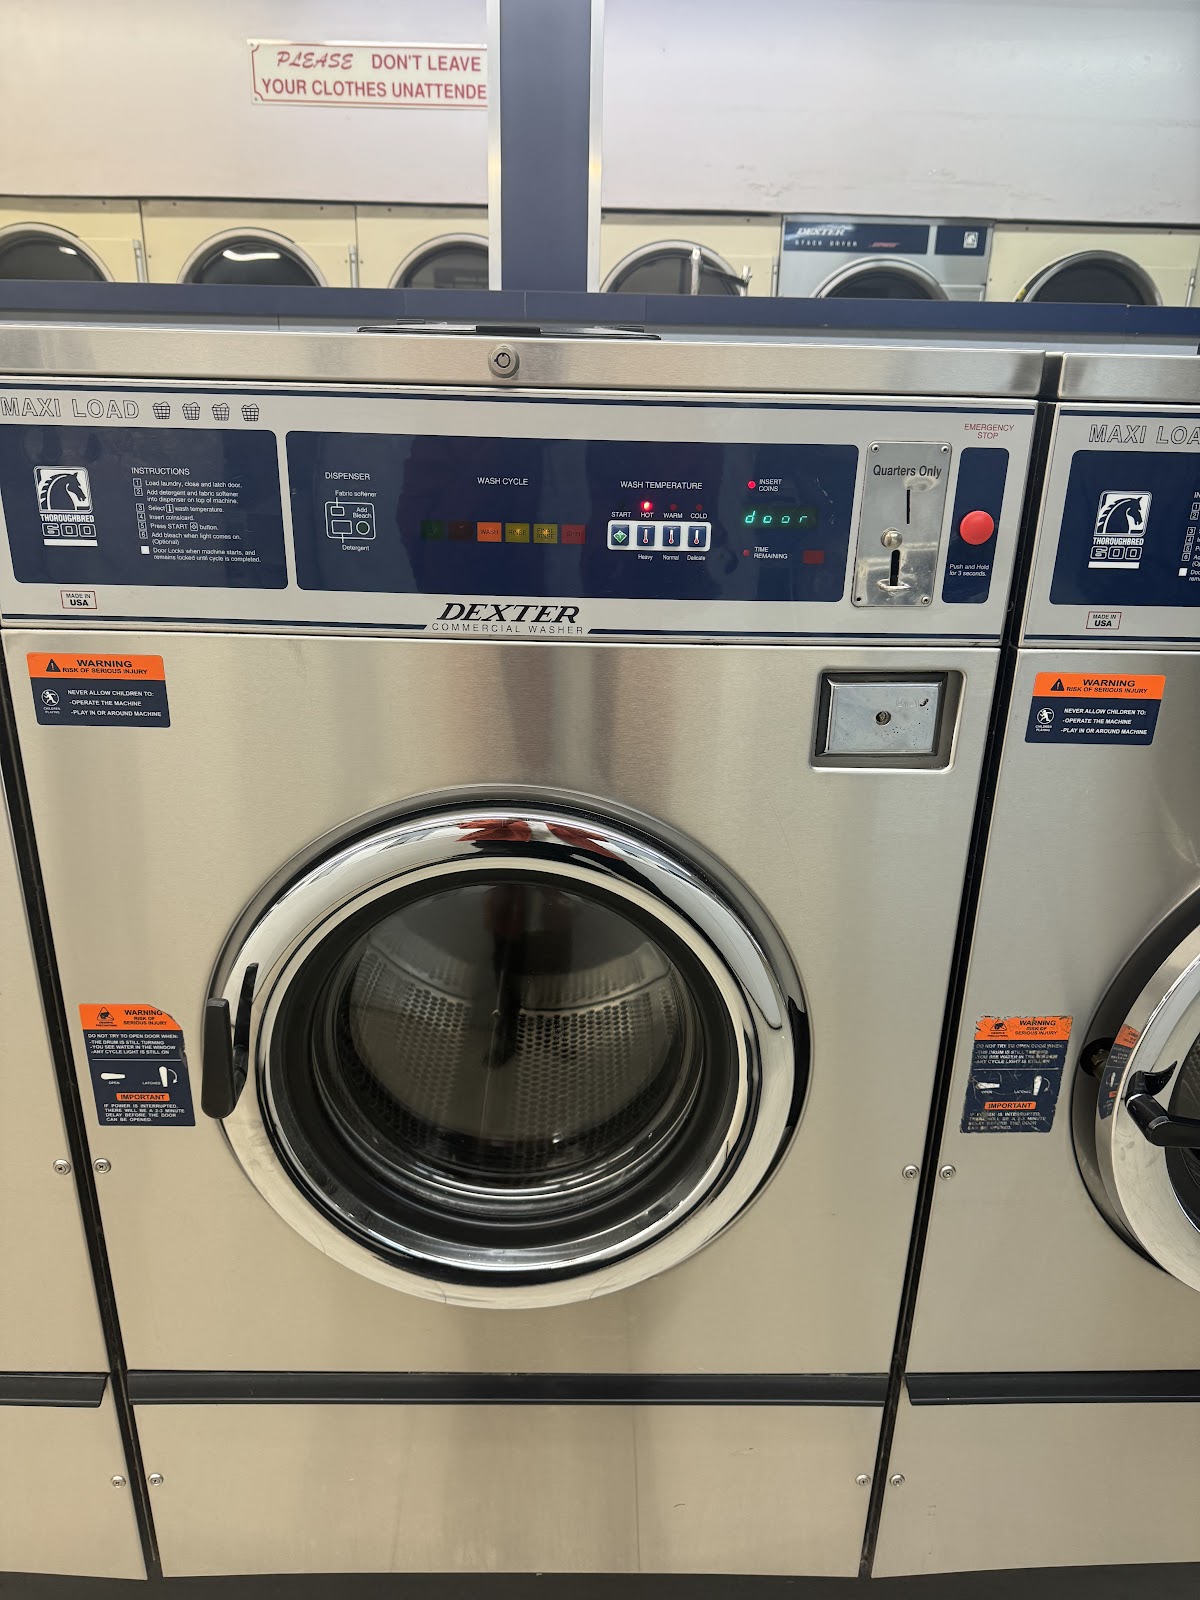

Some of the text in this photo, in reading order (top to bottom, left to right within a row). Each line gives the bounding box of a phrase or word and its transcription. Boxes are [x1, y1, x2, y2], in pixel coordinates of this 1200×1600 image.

[277, 51, 481, 72] PLEASE DON'T LEAVE
[262, 78, 307, 94] YOUR
[312, 80, 387, 97] CLOTHES
[797, 228, 845, 236] DEXTER
[0, 397, 139, 418] MAXI LOAD
[1089, 424, 1147, 444] MAXI
[131, 467, 190, 475] INSTRUCTIONS
[325, 472, 370, 480] DISPENSER
[873, 465, 942, 479] Quarters Only
[646, 481, 702, 490] TEMPERATURE
[159, 490, 186, 498] detergent
[40, 514, 94, 522] THOROUGHBRED
[745, 511, 807, 524] door
[42, 523, 97, 538] 600
[1093, 537, 1144, 546] THOROUGHBRED
[1090, 546, 1142, 560] 600
[436, 602, 580, 623] DEXTER
[432, 623, 583, 634] COMMERCIAL WASHER
